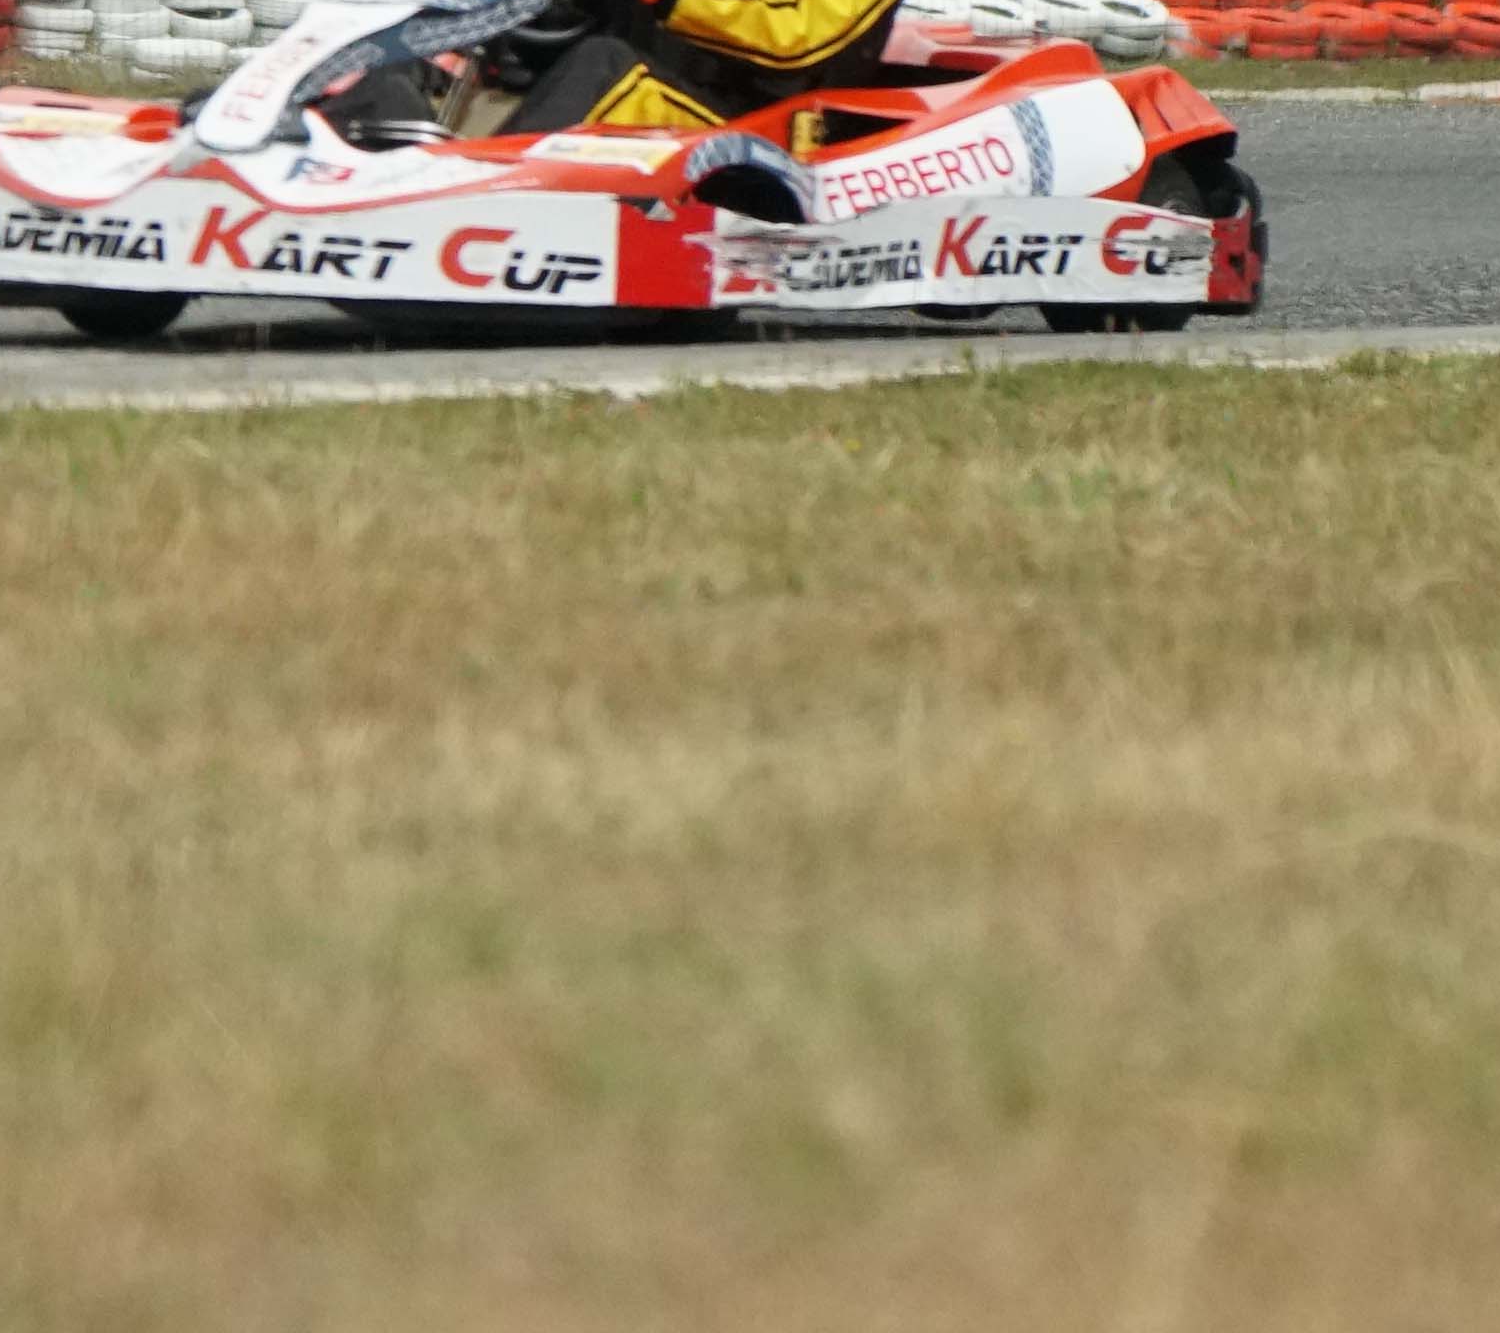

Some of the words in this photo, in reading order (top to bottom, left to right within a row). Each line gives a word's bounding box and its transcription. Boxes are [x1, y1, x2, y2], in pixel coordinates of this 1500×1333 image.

[824, 136, 1015, 215] FERBERTO
[190, 206, 412, 280] KART
[438, 226, 603, 294] CUP
[935, 215, 1083, 276] KART
